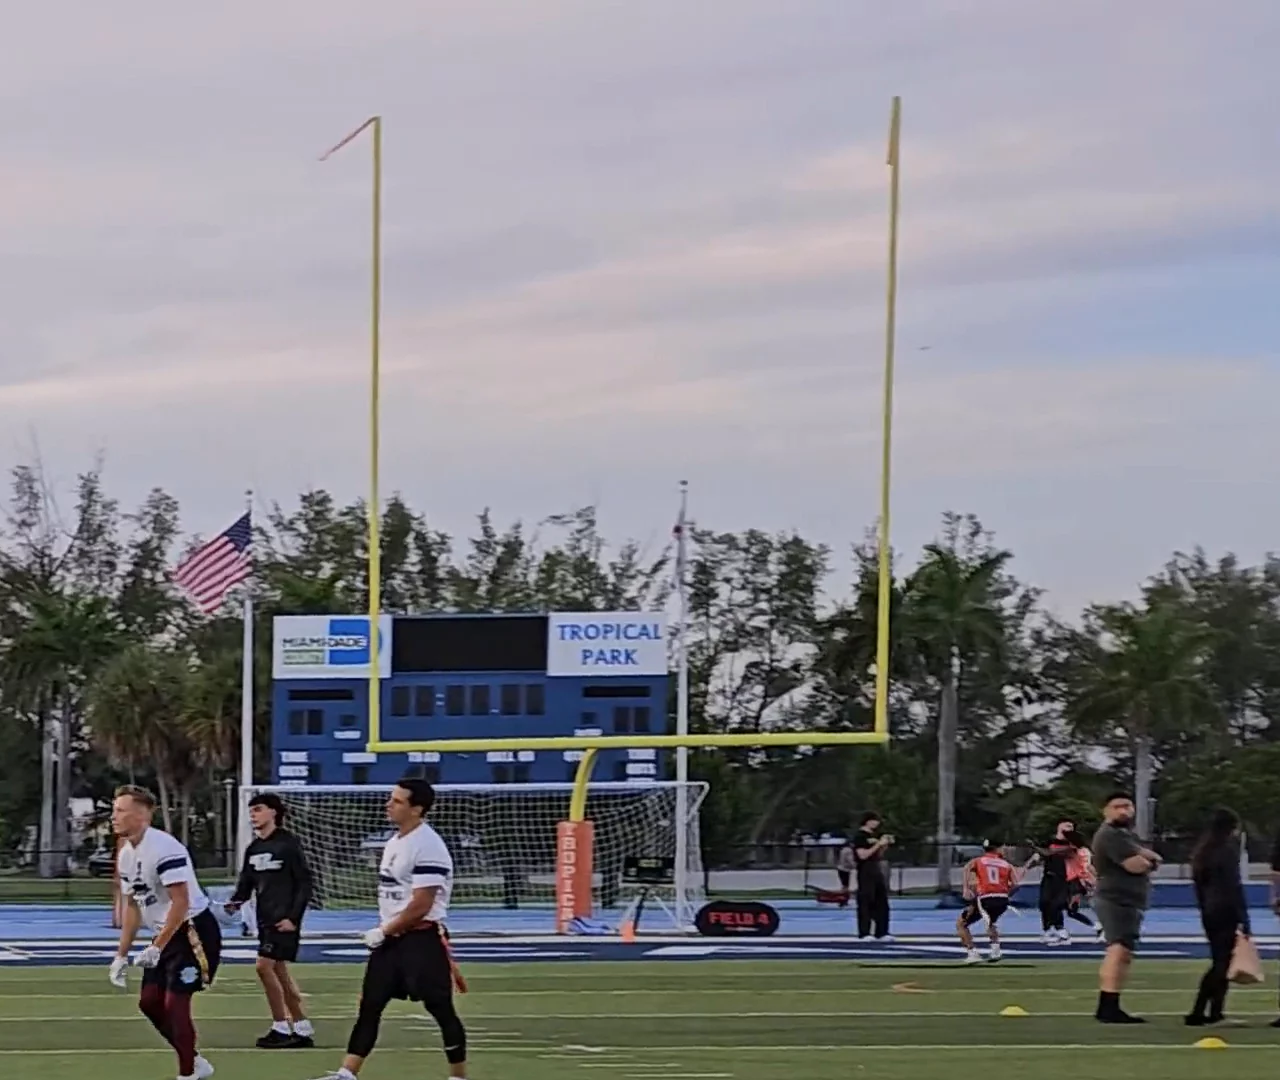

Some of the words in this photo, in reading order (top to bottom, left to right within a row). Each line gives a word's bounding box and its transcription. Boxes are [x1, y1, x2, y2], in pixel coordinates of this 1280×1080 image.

[557, 624, 663, 640] TROPICAL
[581, 648, 639, 665] PARK
[708, 911, 754, 925] FIELD
[757, 911, 770, 925] 4
